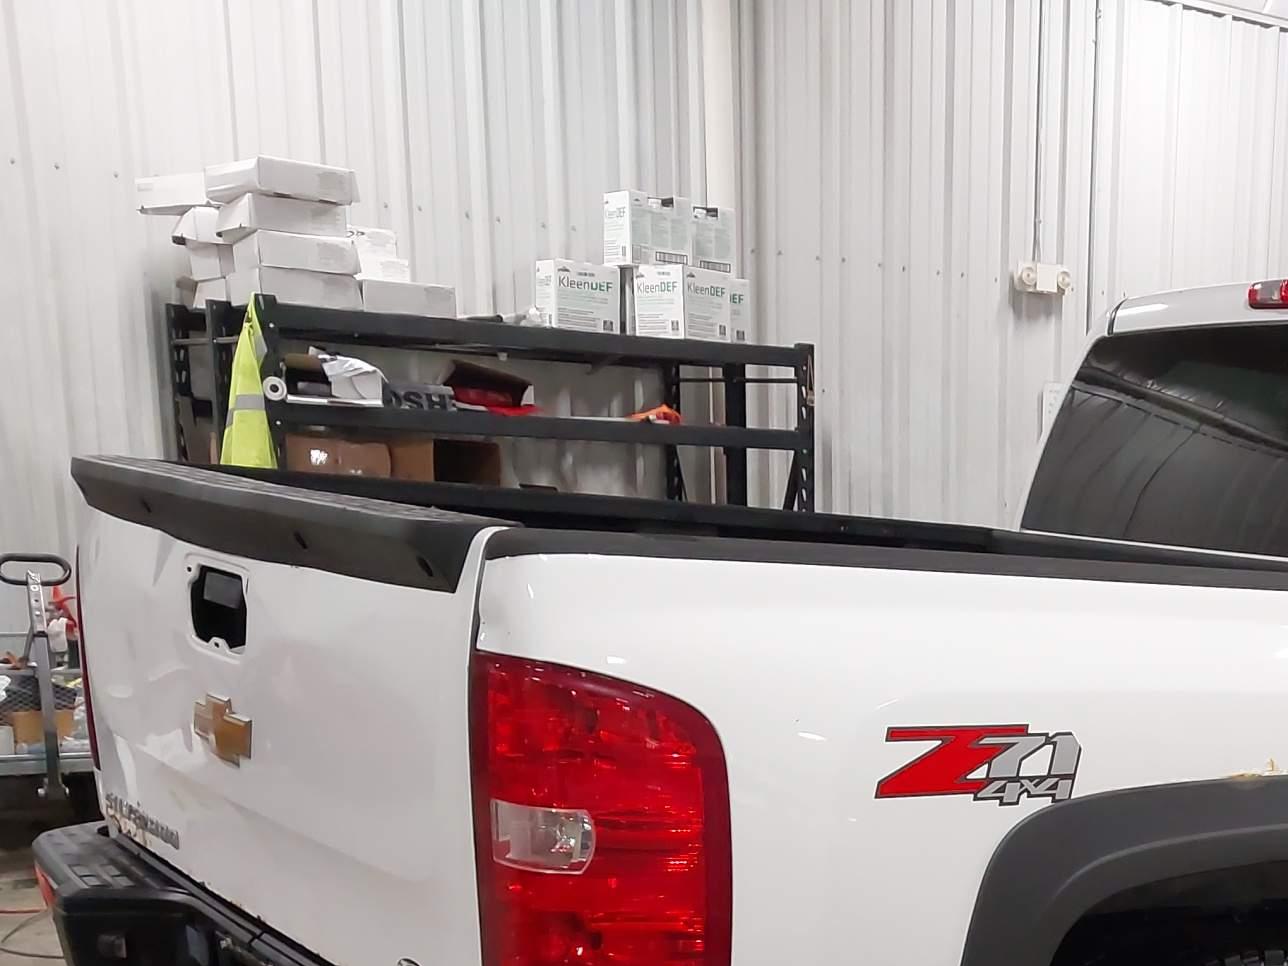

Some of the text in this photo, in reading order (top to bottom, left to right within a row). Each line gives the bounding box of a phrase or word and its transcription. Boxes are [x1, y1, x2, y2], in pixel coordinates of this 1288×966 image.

[558, 276, 613, 292] KleenDEF
[636, 281, 678, 294] KleenDEF
[687, 283, 726, 297] KleenDEF
[875, 724, 1081, 799] Z71
